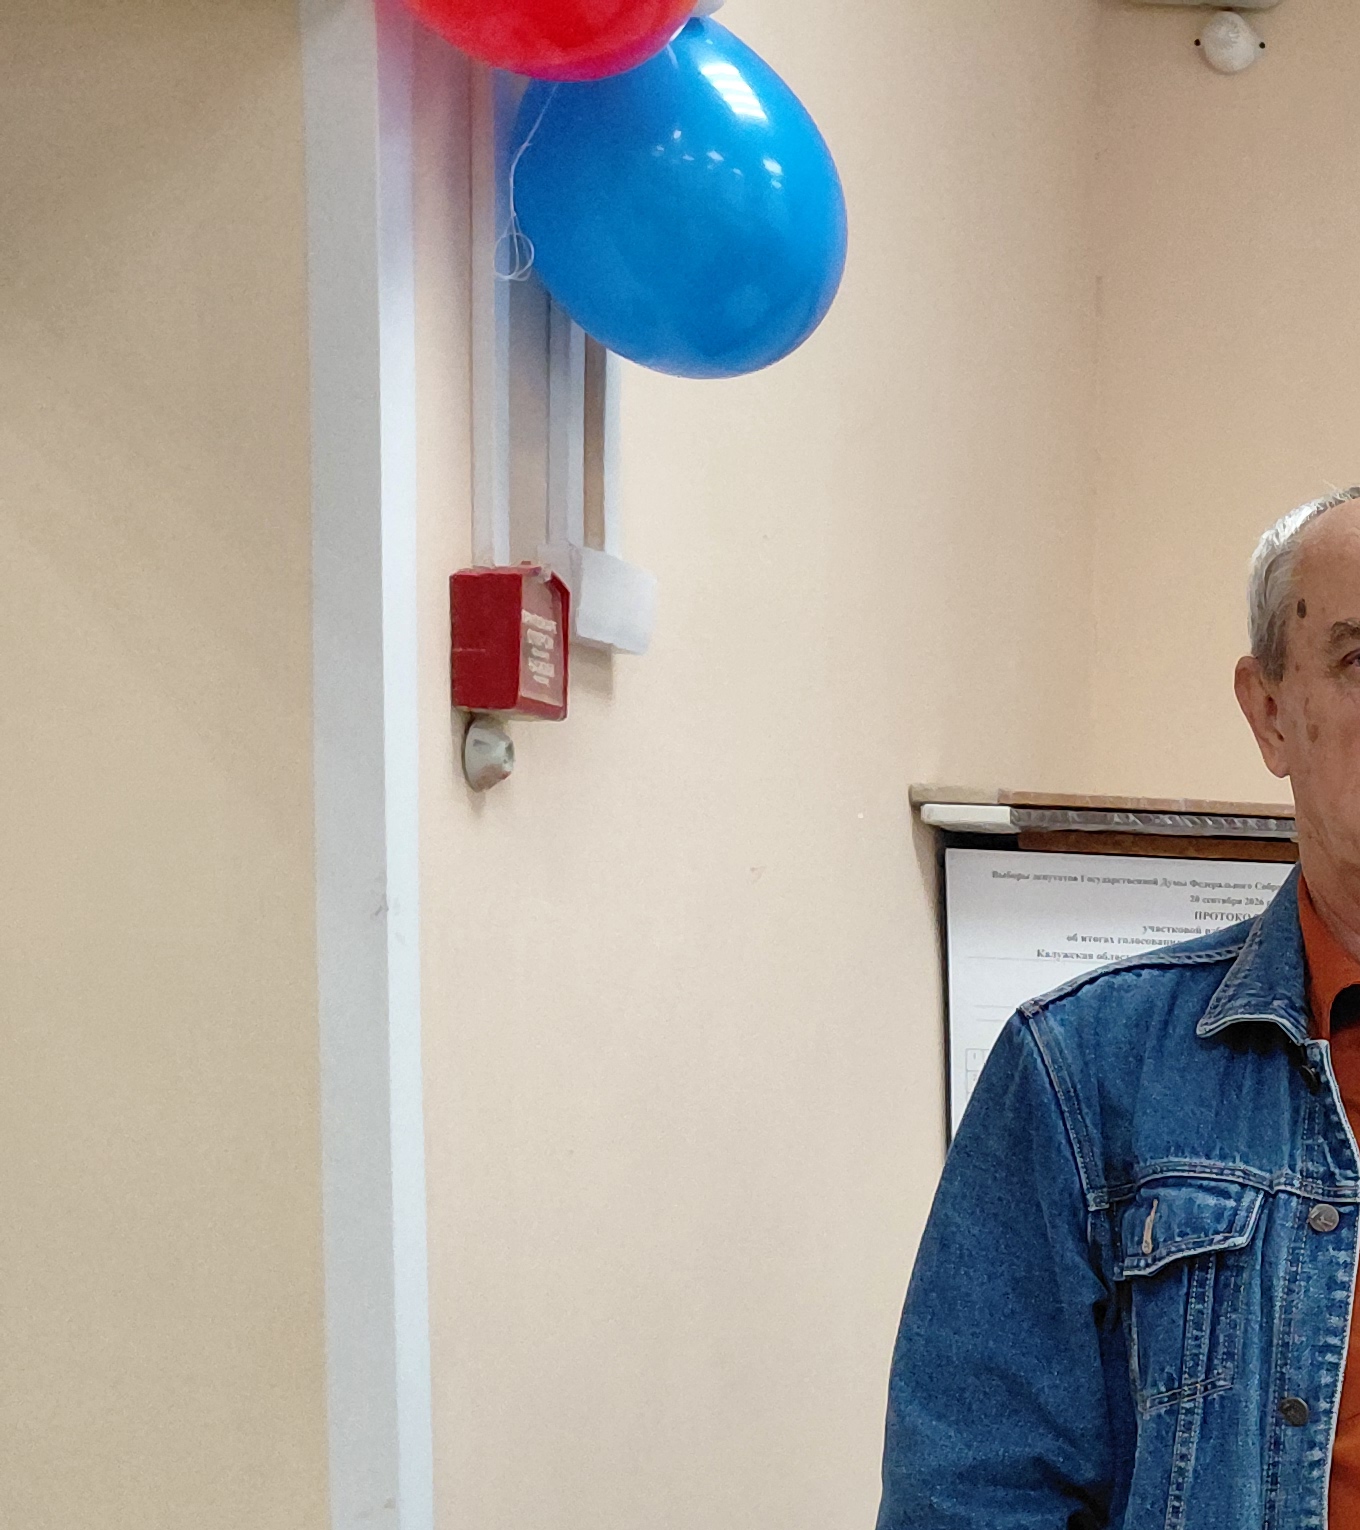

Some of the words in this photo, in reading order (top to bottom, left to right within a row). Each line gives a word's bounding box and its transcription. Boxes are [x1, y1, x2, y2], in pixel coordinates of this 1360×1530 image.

[1160, 878, 1187, 888] Думы
[1190, 880, 1252, 890] Федерального
[1255, 881, 1281, 892] Собр
[1202, 895, 1242, 906] сентября
[1143, 925, 1201, 935] участковой
[1066, 933, 1078, 942] об
[1081, 935, 1115, 944] итогах
[1037, 949, 1093, 961] Калужская
[1096, 952, 1130, 961] облас
